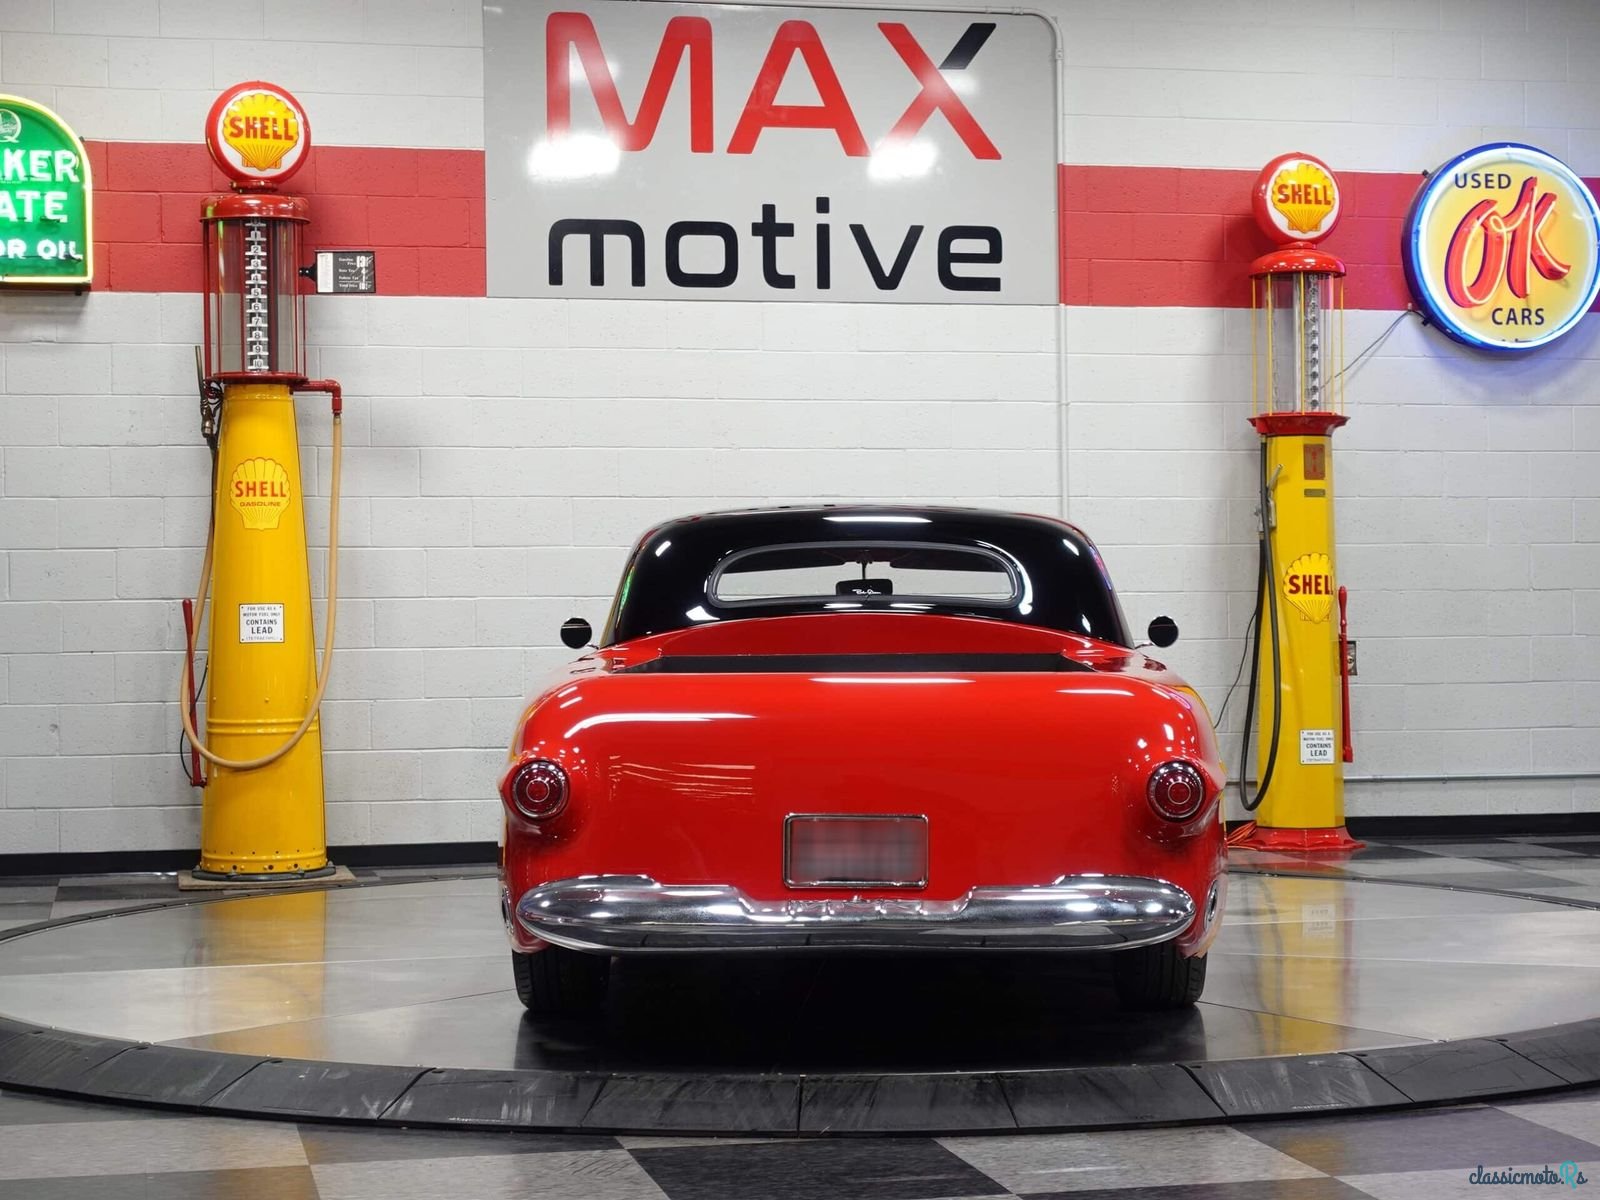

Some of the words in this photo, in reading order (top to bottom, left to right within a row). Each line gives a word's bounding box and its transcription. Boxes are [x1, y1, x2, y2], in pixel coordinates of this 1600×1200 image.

[545, 11, 1003, 160] MAX
[228, 115, 294, 141] SHELL
[1454, 173, 1512, 190] USED
[1277, 183, 1331, 206] SHELL
[37, 239, 84, 260] OIL
[253, 246, 259, 254] 2
[547, 196, 1003, 292] motive
[1443, 176, 1572, 309] OK
[253, 260, 259, 268] 3
[253, 288, 259, 296] 5
[253, 303, 260, 311] 6
[1491, 307, 1545, 326] CARS
[254, 332, 261, 340] 8
[254, 346, 261, 354] 9
[254, 360, 263, 368] 10
[234, 480, 287, 498] SHELL
[1288, 574, 1334, 596] SHELL
[1310, 749, 1328, 757] LEAD
